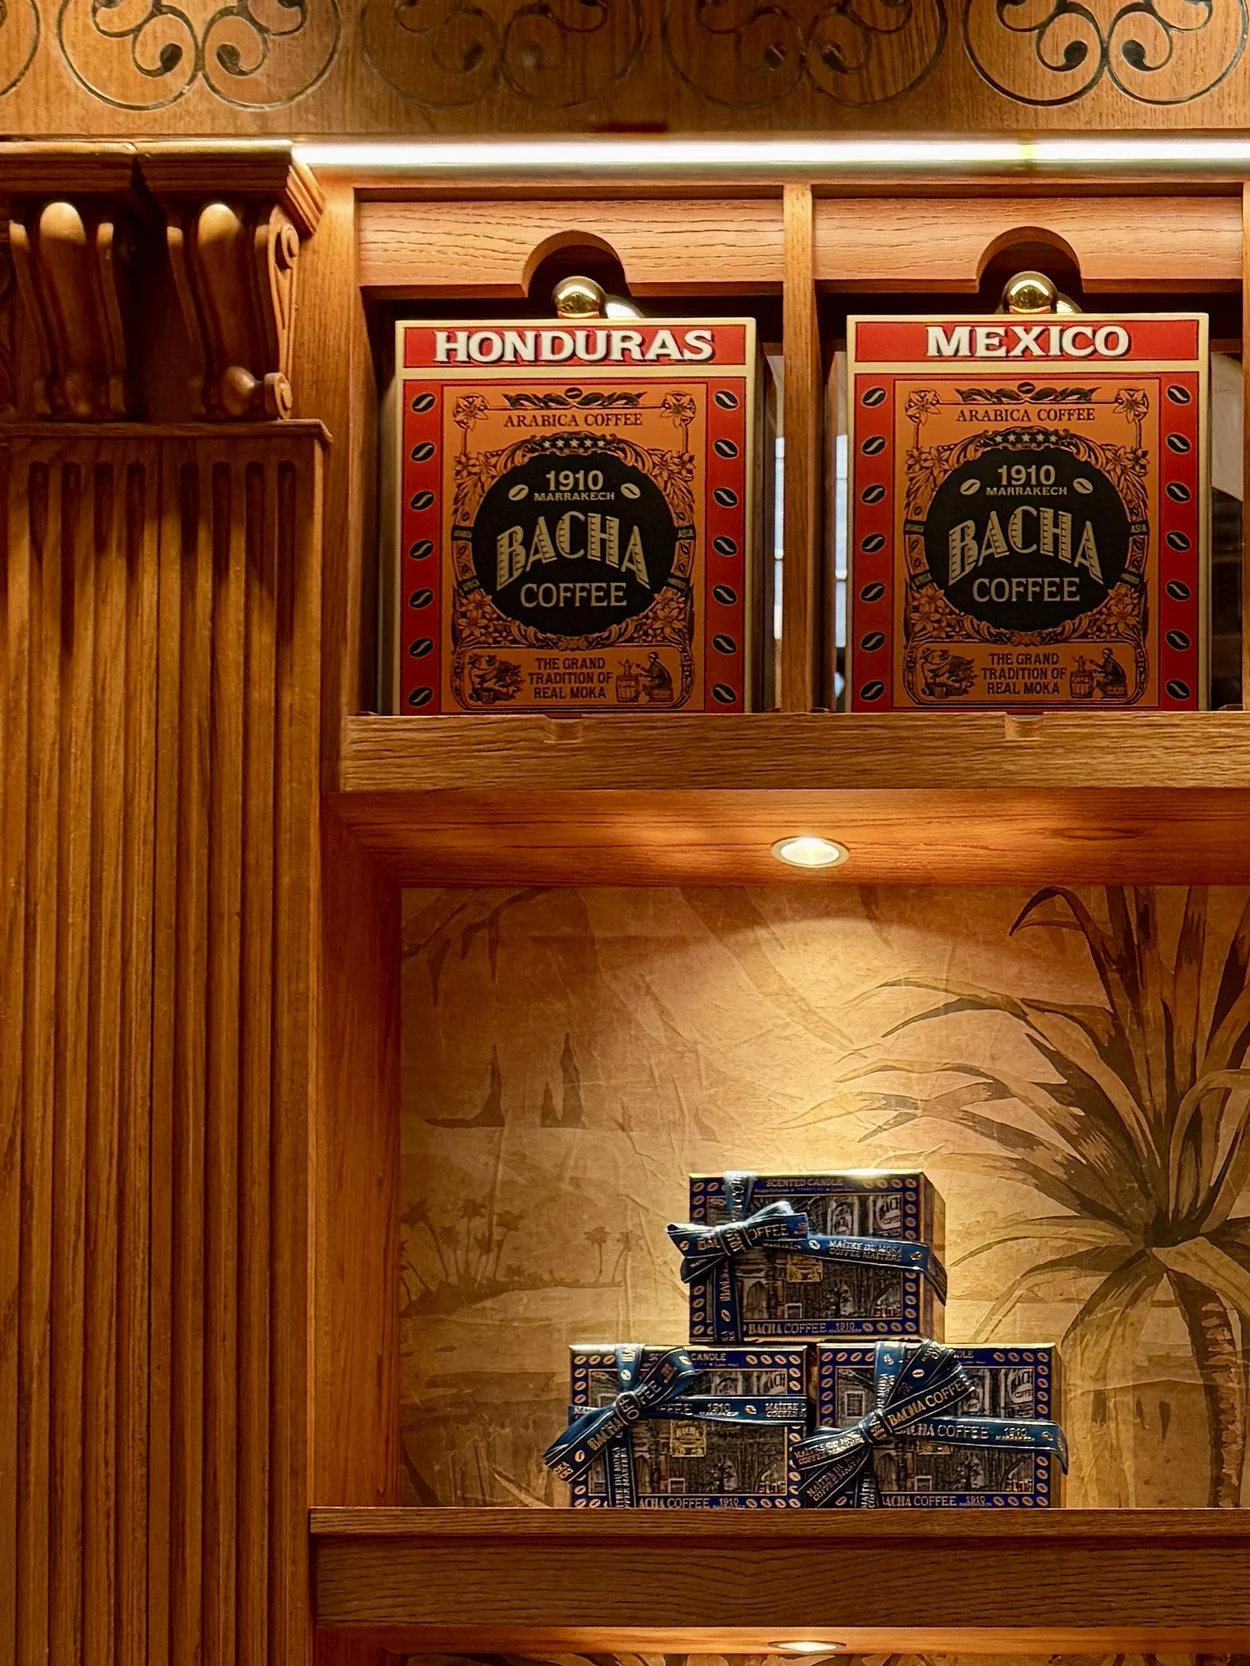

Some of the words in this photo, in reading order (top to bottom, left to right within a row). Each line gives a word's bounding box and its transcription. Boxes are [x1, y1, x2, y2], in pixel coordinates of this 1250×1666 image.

[433, 329, 716, 363] HONDURAS
[925, 324, 1131, 358] MEXICO
[504, 413, 579, 428] ARABICA
[583, 412, 643, 427] COFFEE
[956, 408, 1031, 422] ARABICA
[1036, 407, 1095, 422] COFFEE
[545, 470, 603, 489] 1910
[997, 464, 1056, 485] 1910
[533, 491, 615, 502] MARRAKECH
[985, 486, 1067, 496] MARRAKECH
[496, 510, 650, 590] BACHA
[948, 505, 1103, 586] BACHA
[520, 582, 627, 608] COFFEE
[972, 577, 1080, 602] COFFEE
[535, 657, 560, 670] THE
[563, 657, 605, 670] GRAND
[988, 652, 1014, 666] THE
[1016, 652, 1059, 666] GRAND
[528, 672, 595, 685] TRADITION
[598, 671, 613, 685] OF
[981, 667, 1048, 680] TRADITION
[1050, 667, 1067, 680] OF
[534, 686, 568, 699] REAL
[569, 686, 607, 699] MOKA
[987, 681, 1021, 695] REAL
[1024, 681, 1060, 695] MOKA
[750, 1323, 782, 1335] BACHA
[783, 1323, 826, 1334] COFFEE
[691, 1353, 726, 1361] CANDLE
[937, 1425, 988, 1439] COFFEE
[667, 1498, 709, 1508] COFFEE
[914, 1496, 956, 1506] COFFEE
